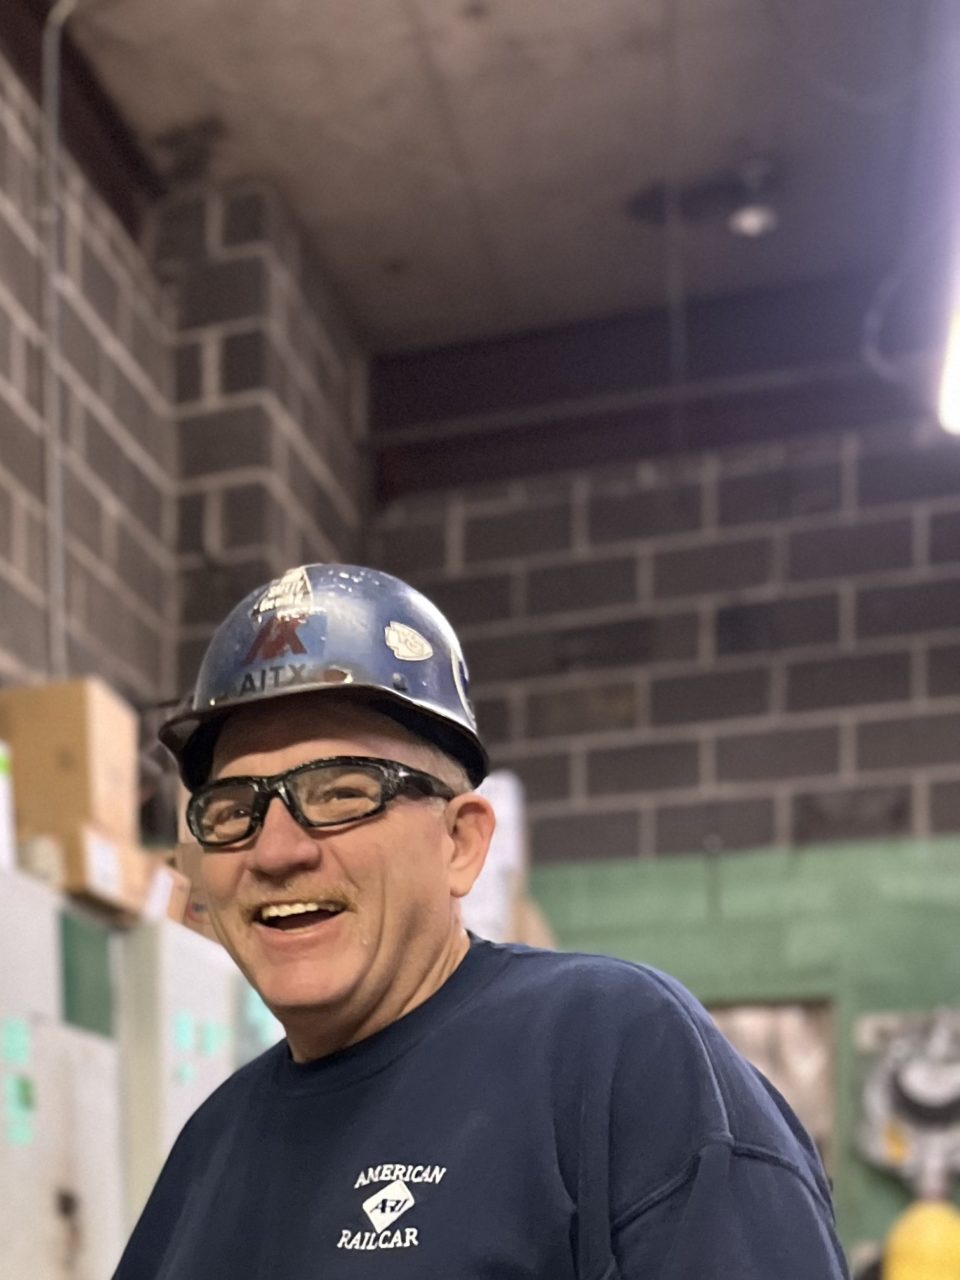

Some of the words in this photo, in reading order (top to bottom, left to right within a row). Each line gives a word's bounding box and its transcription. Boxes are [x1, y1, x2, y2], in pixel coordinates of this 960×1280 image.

[240, 663, 306, 695] AITX
[354, 1164, 446, 1188] AMERICAN
[337, 1228, 418, 1250] RAILCAR
